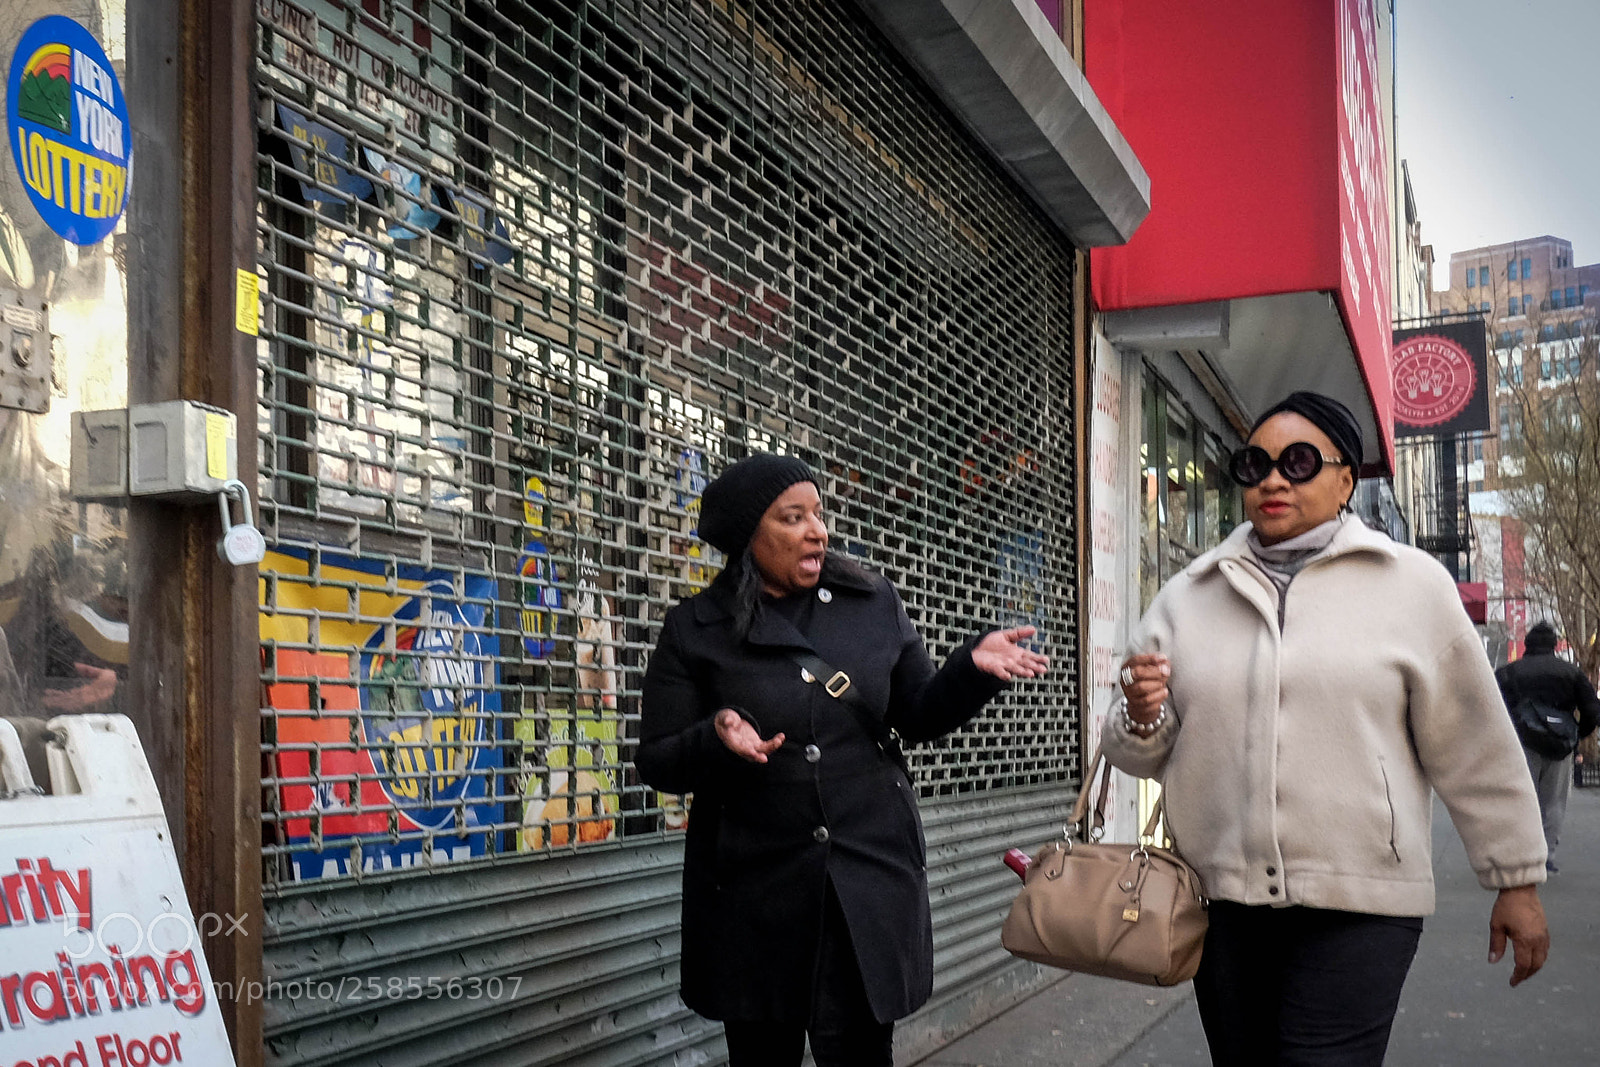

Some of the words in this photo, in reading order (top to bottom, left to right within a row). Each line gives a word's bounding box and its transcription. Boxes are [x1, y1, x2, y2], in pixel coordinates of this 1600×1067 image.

[73, 48, 115, 109] NEW
[74, 90, 124, 159] YORK
[18, 126, 128, 219] LOTTERY
[1417, 343, 1461, 365] FACTORY
[416, 609, 457, 650] NEW
[377, 701, 478, 799] LOTTERY
[0, 944, 206, 1032] raining
[95, 1031, 183, 1067] Floor
